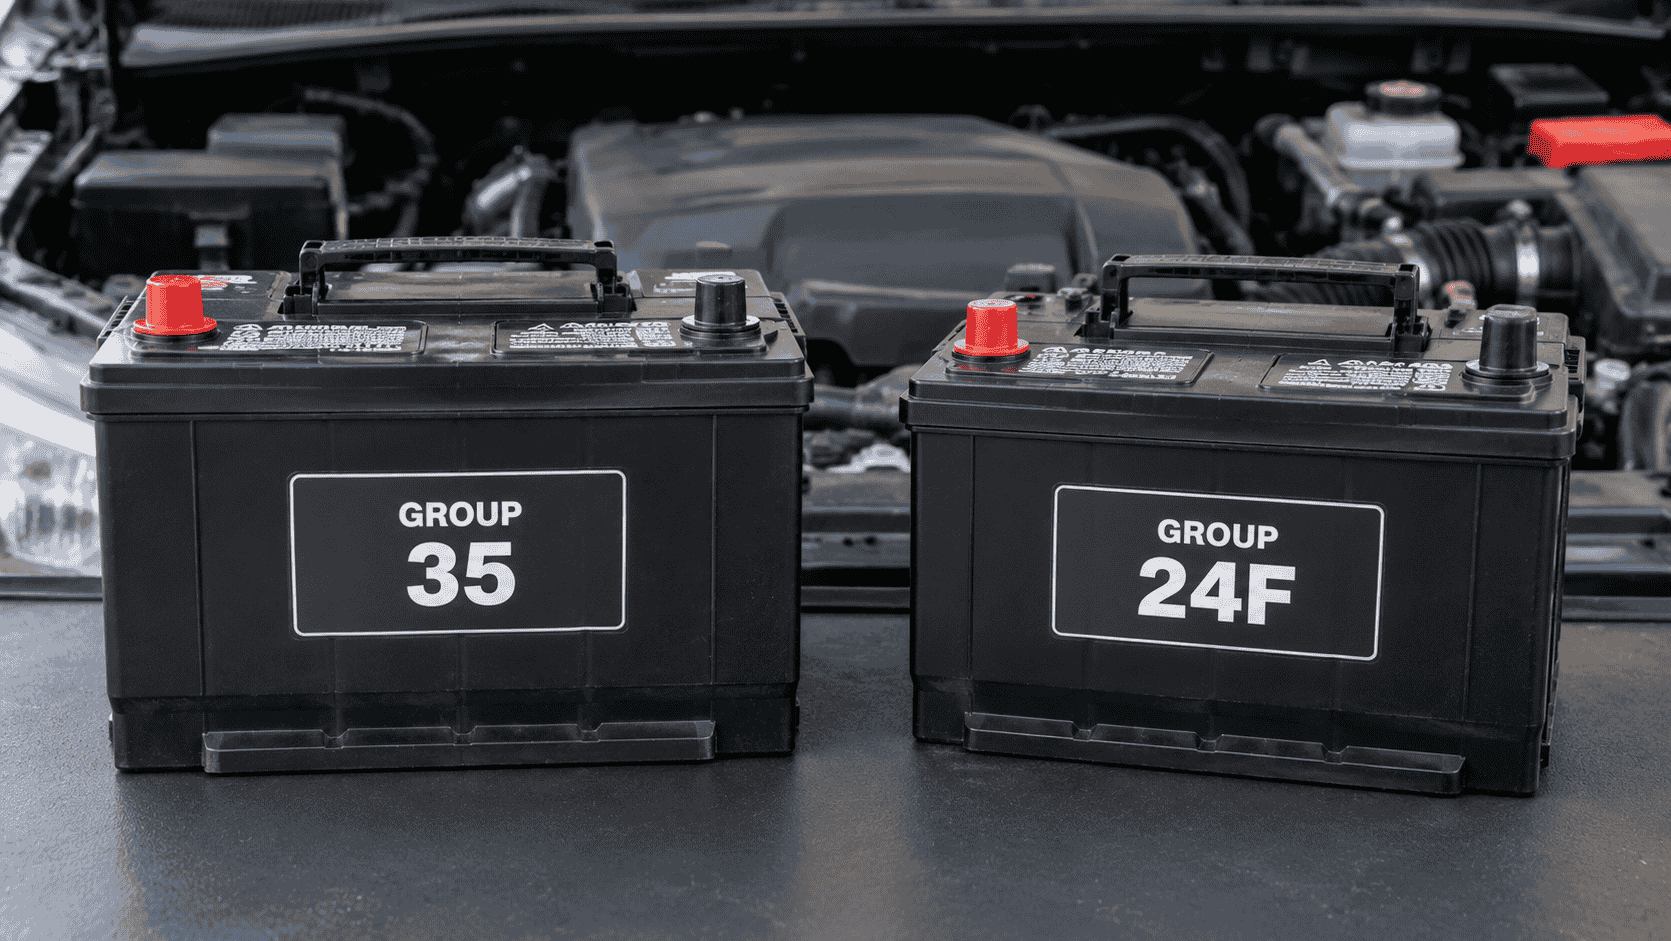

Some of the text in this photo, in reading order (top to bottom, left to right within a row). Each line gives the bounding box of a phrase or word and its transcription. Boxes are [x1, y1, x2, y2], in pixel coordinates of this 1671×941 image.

[399, 501, 522, 527] GROUP
[1158, 519, 1278, 549] GROUP
[407, 542, 515, 606] 35
[1138, 557, 1295, 625] 24F
